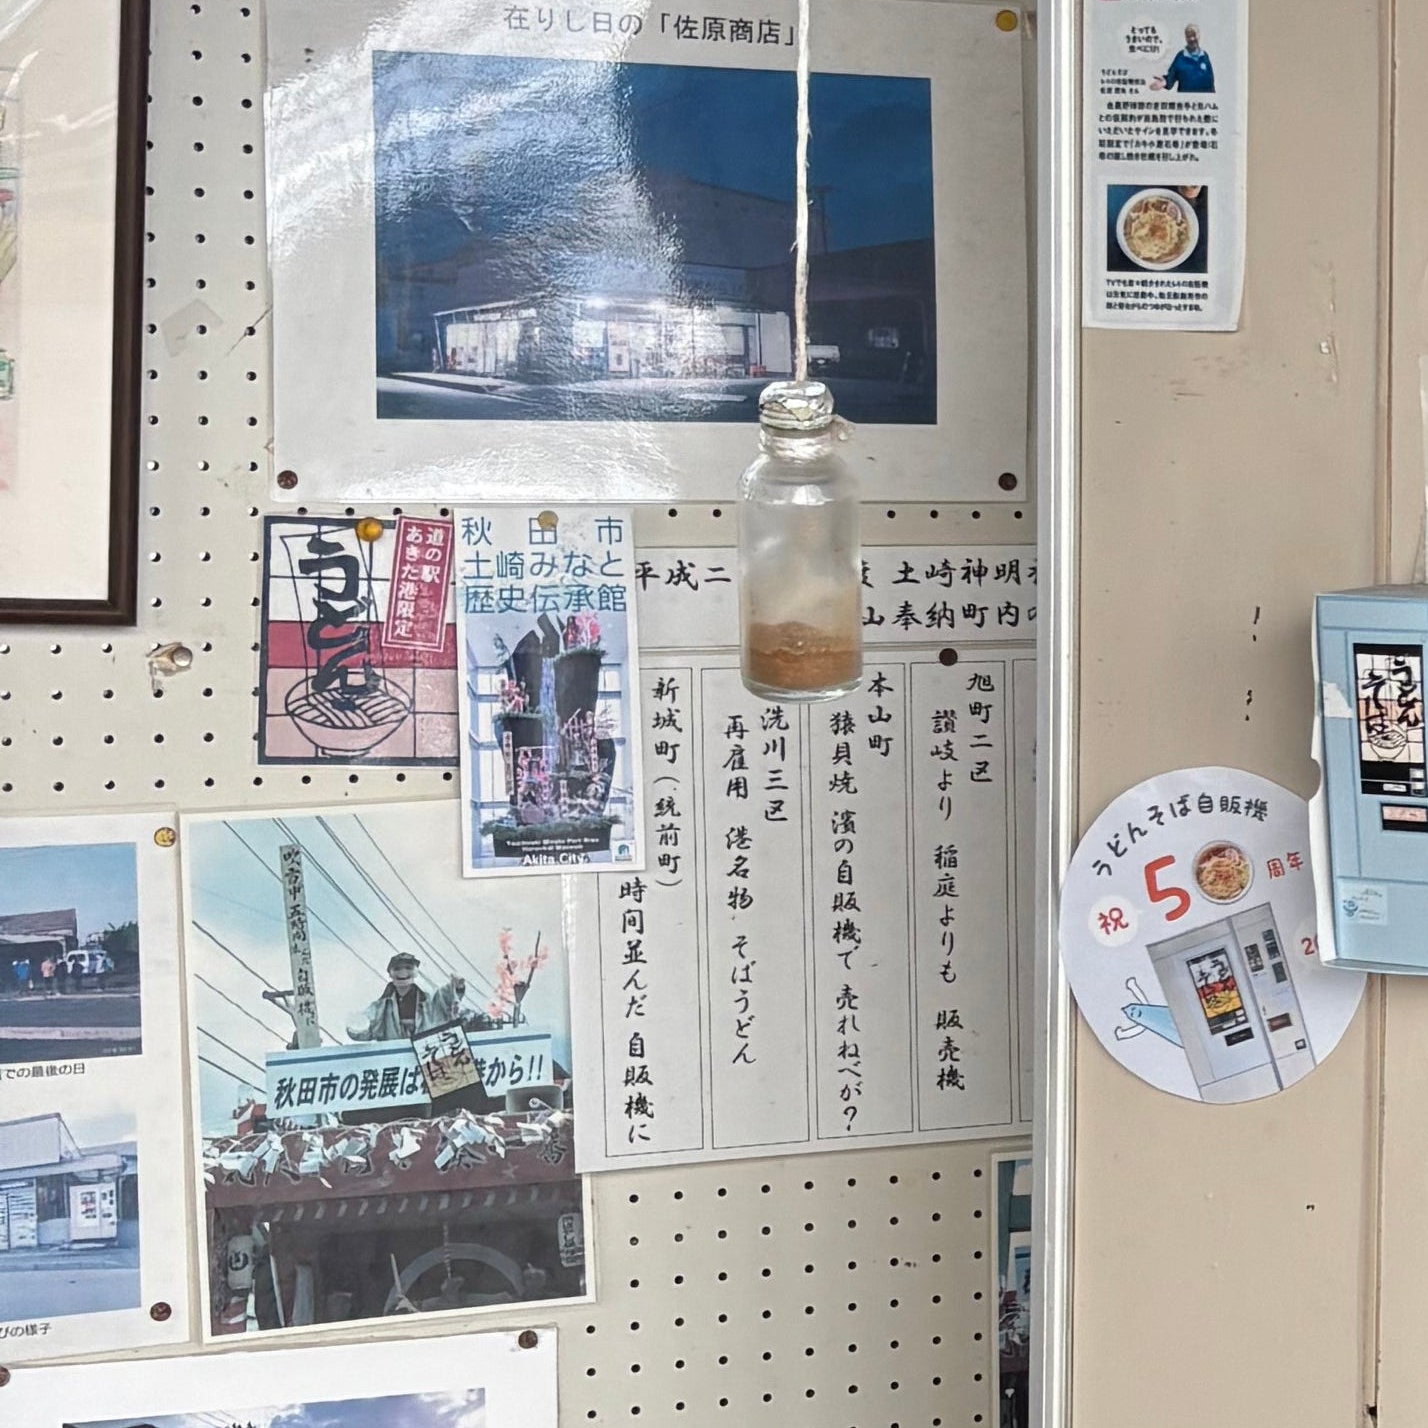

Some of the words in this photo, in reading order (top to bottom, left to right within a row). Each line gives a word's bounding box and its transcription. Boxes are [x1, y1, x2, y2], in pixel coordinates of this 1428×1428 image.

[503, 4, 797, 49] 在りし日の「佐原商店」
[419, 524, 445, 584] 道の駅
[463, 550, 624, 581] 土崎みなと
[394, 525, 423, 639] あきた港限定
[464, 583, 627, 614] 歴史伝承館
[867, 671, 896, 758] 本山町
[965, 671, 996, 784] 旭町二区
[521, 853, 556, 867] Akita
[1090, 791, 1271, 878] うどんそば自販機
[1096, 905, 1129, 936] 祝
